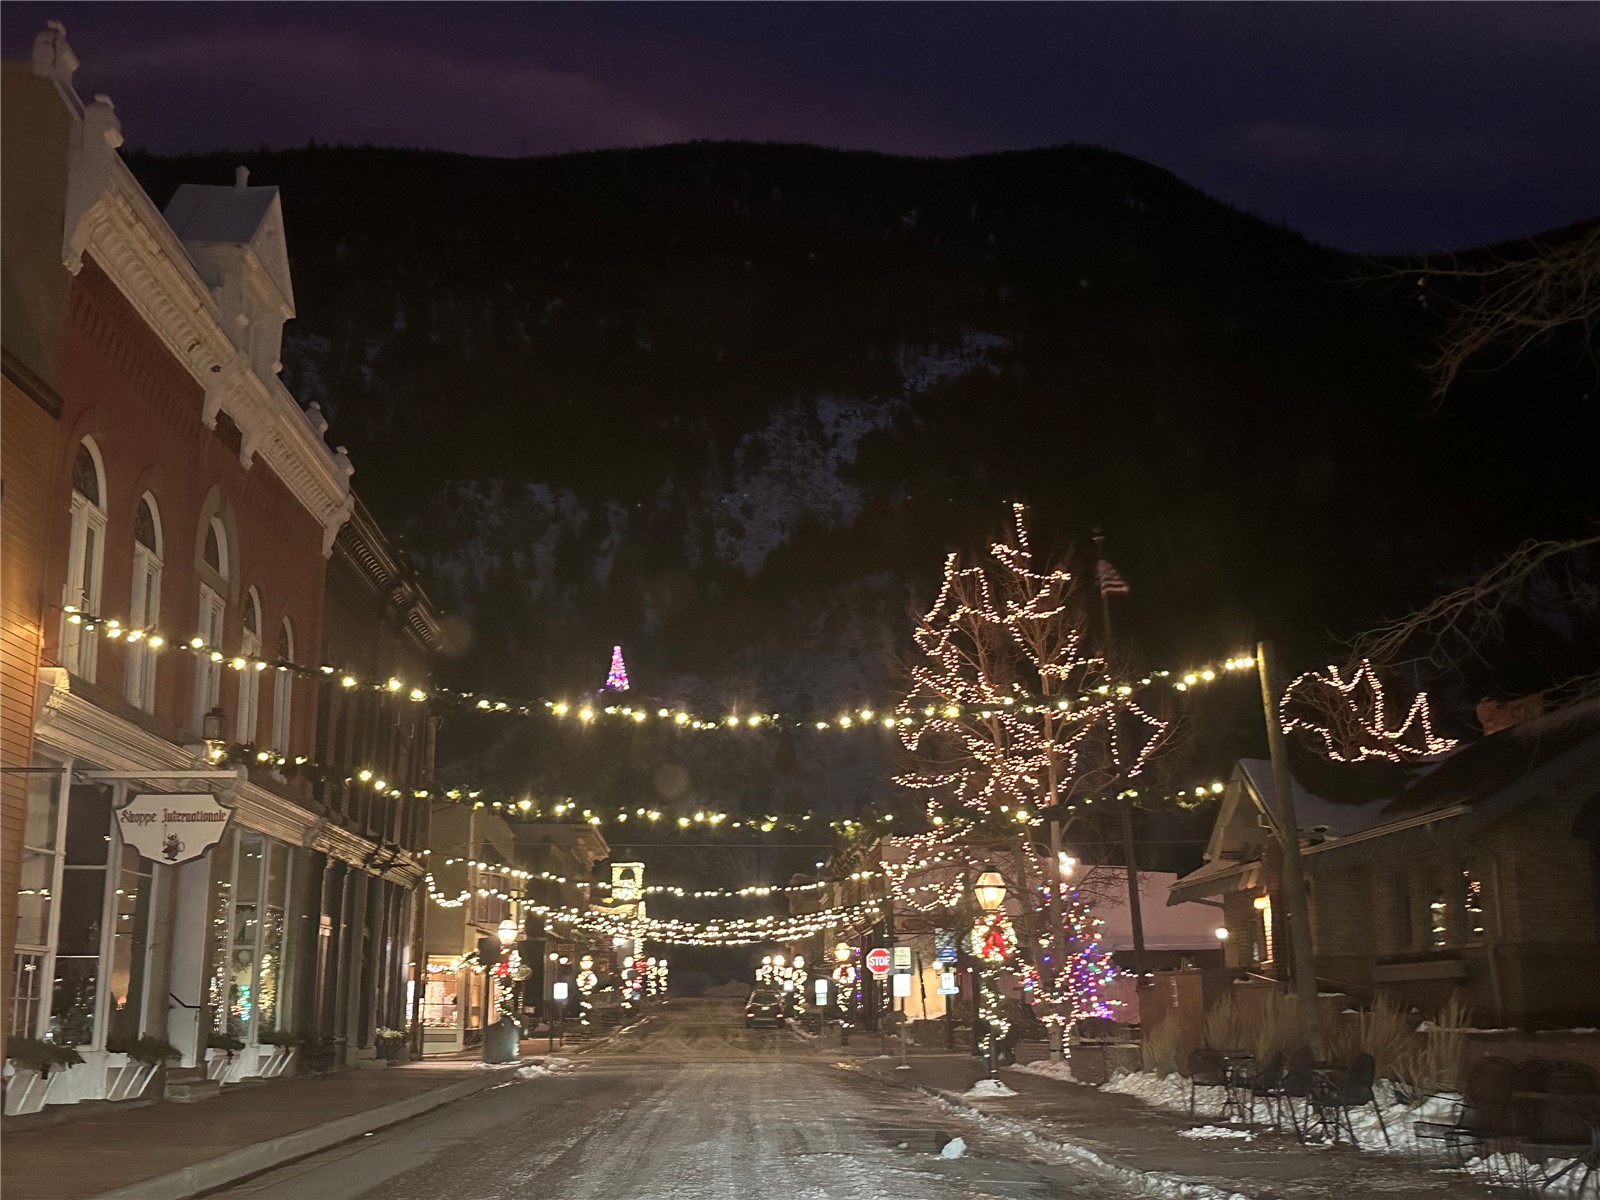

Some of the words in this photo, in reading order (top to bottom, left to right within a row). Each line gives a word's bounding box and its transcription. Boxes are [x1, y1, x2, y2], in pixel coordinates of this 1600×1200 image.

[121, 809, 157, 826] Shoppe
[161, 808, 226, 823] Internationale
[869, 955, 890, 967] STOP
